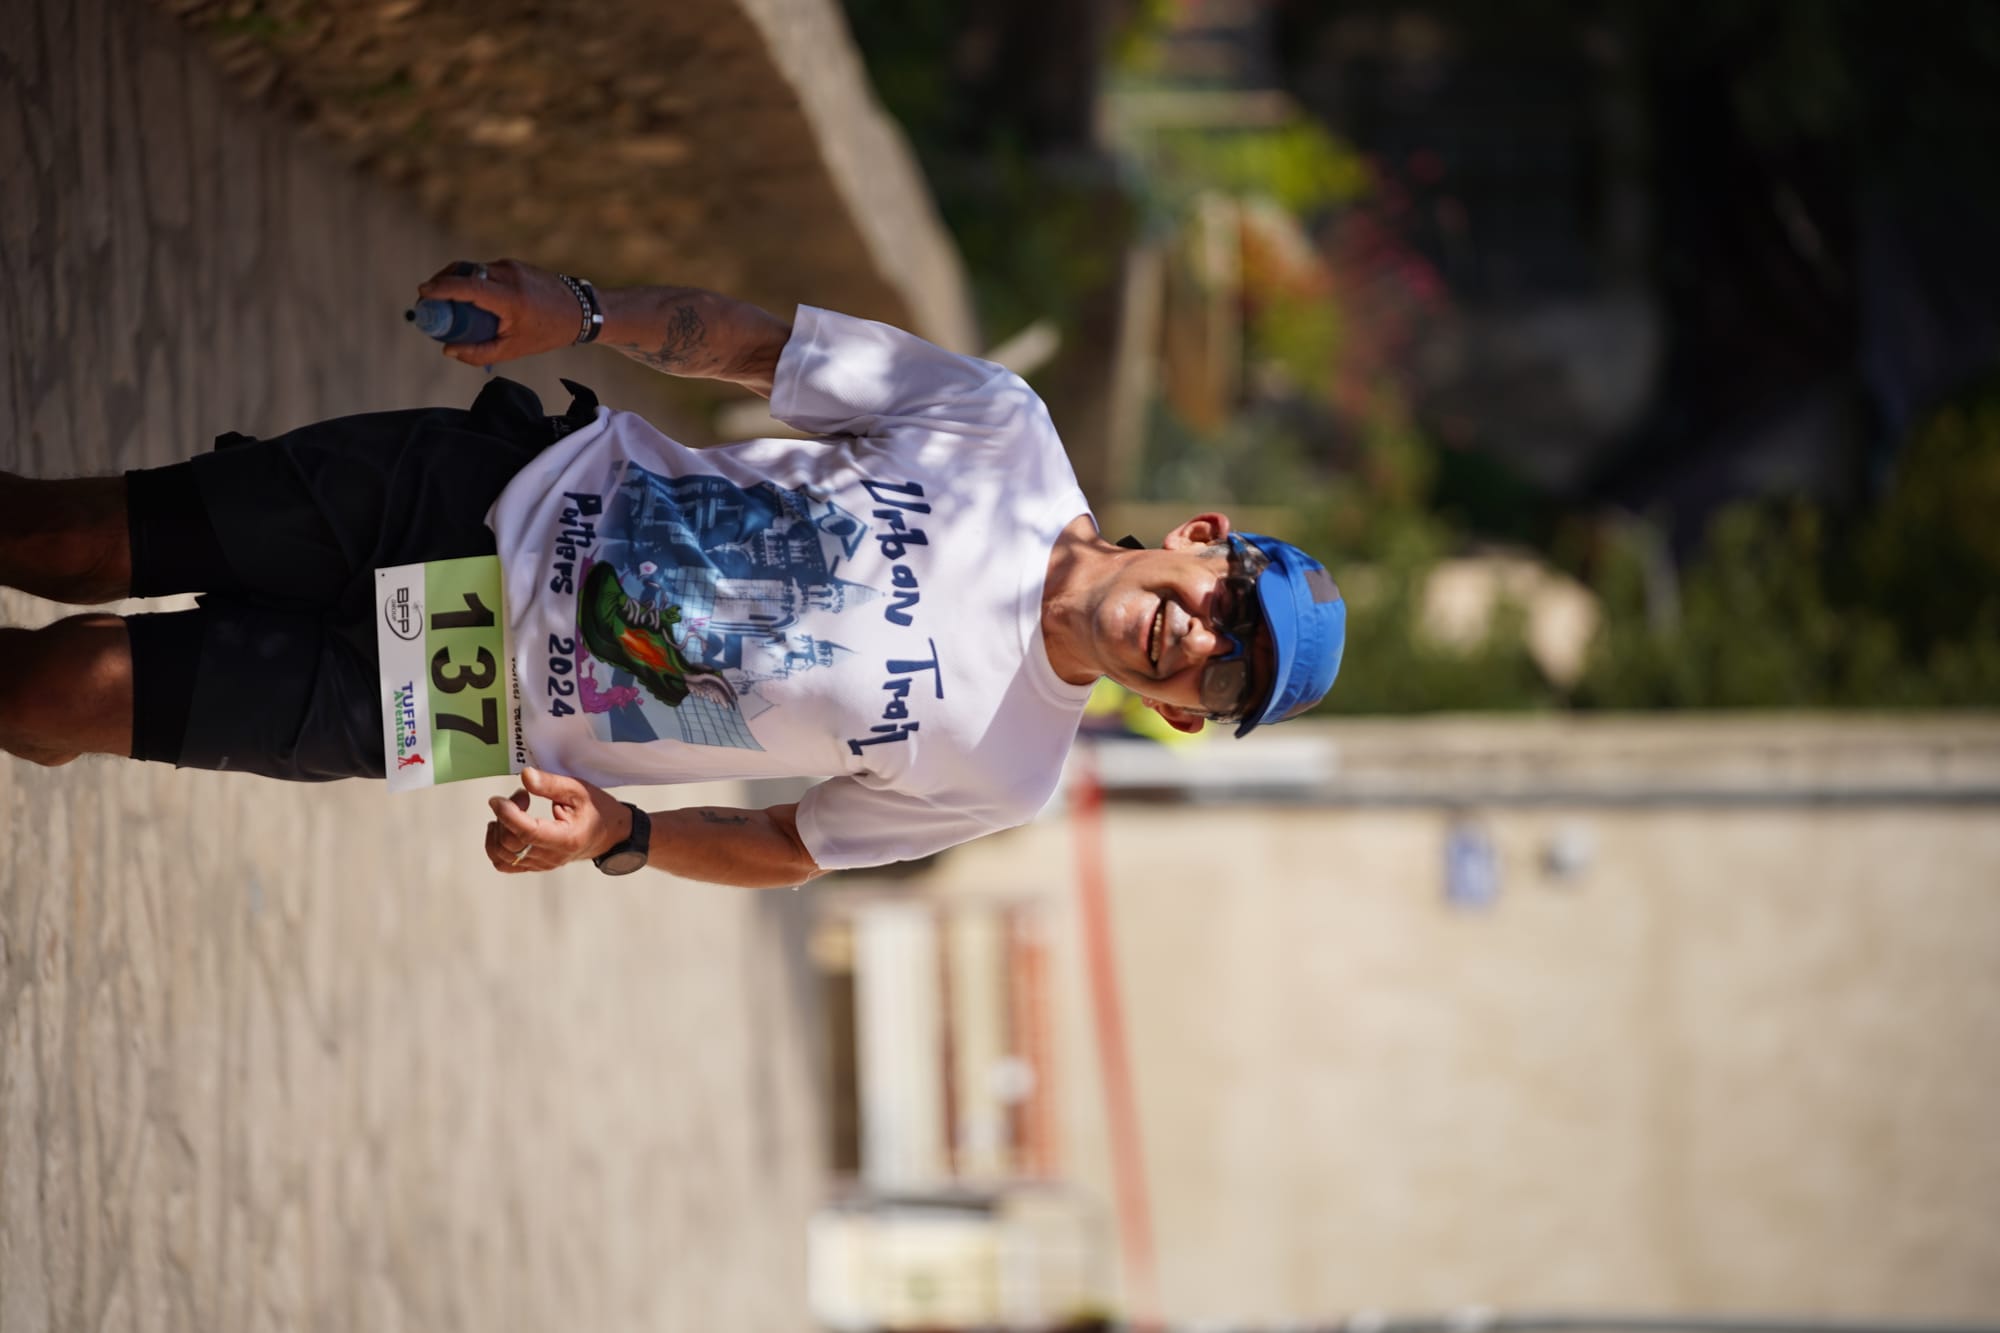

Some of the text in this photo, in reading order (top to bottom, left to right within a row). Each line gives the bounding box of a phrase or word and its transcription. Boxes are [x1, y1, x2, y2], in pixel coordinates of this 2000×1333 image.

[396, 587, 409, 634] BFP
[548, 491, 602, 718] Poitiers 2024
[401, 681, 417, 748] TUFF'S
[430, 592, 499, 745] 137
[847, 637, 945, 756] Trail
[393, 690, 405, 756] Aventure
